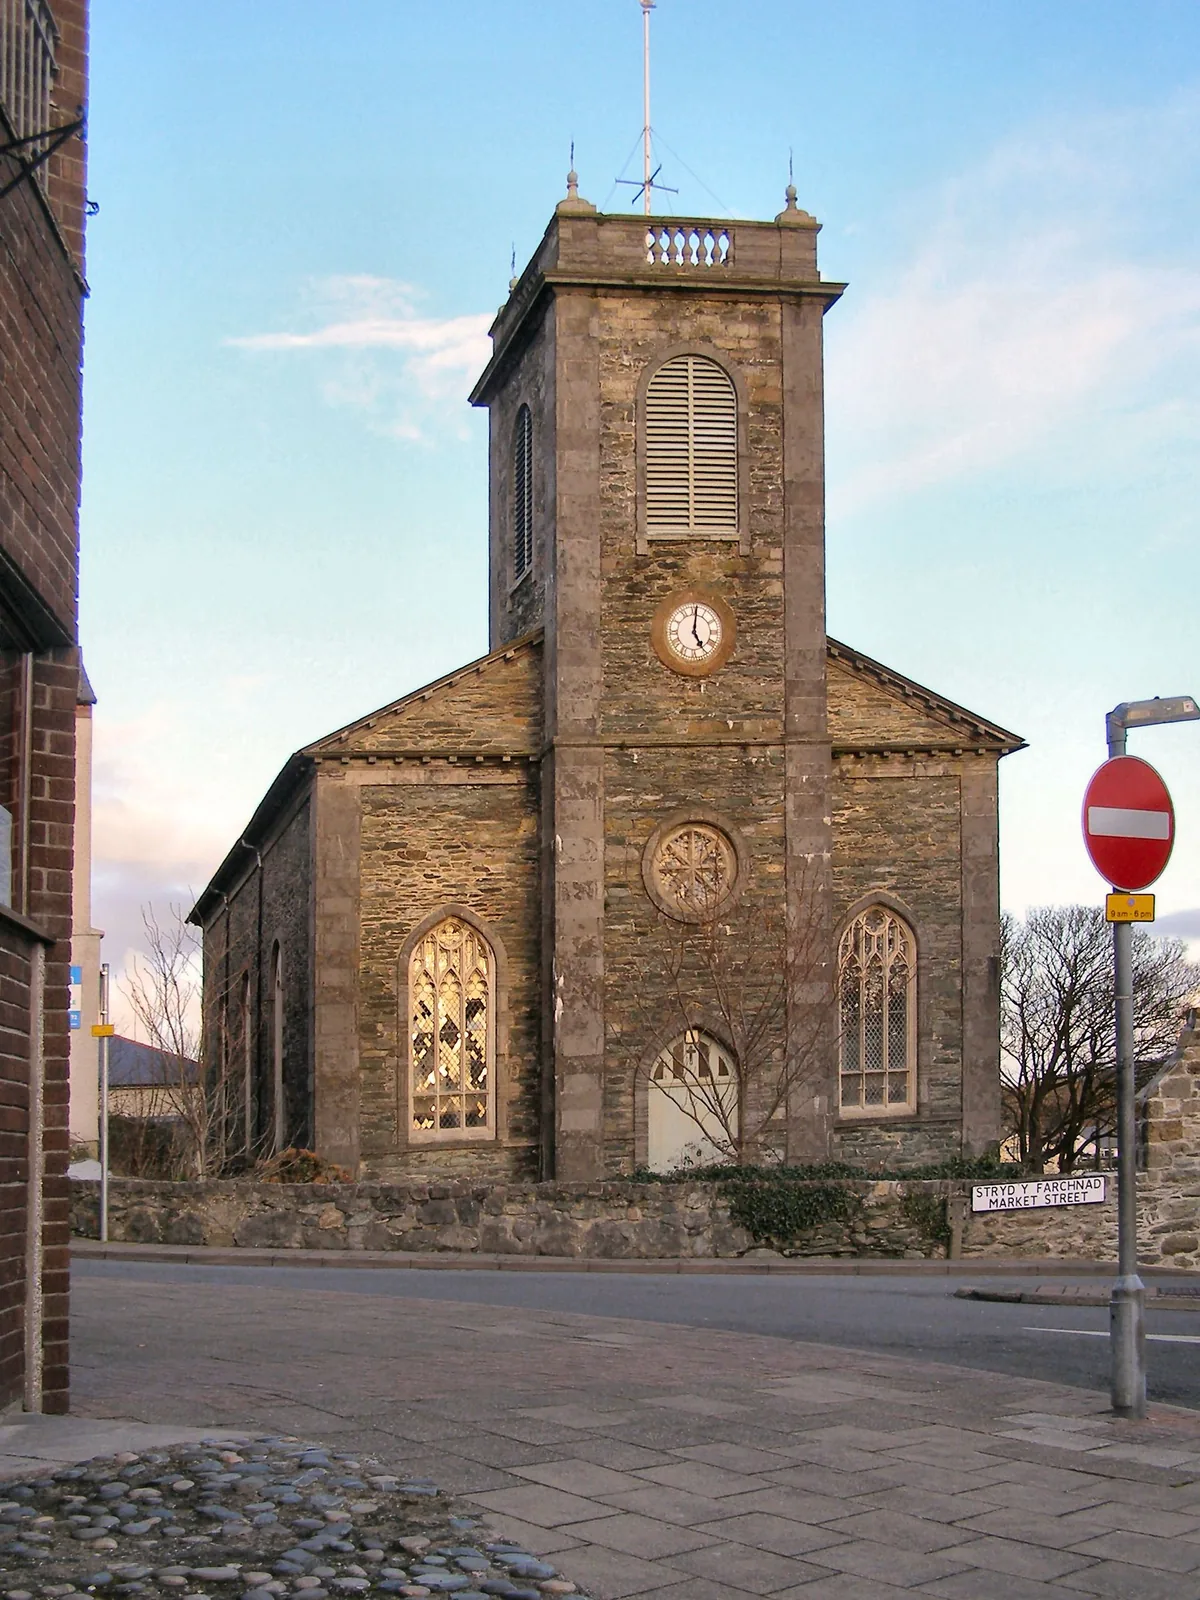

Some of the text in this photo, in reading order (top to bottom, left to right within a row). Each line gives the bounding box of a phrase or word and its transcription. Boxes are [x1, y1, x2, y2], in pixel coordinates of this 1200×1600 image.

[976, 1179, 1102, 1198] STRYD Y FARCHNAD
[989, 1191, 1089, 1209] MARKET STREET
